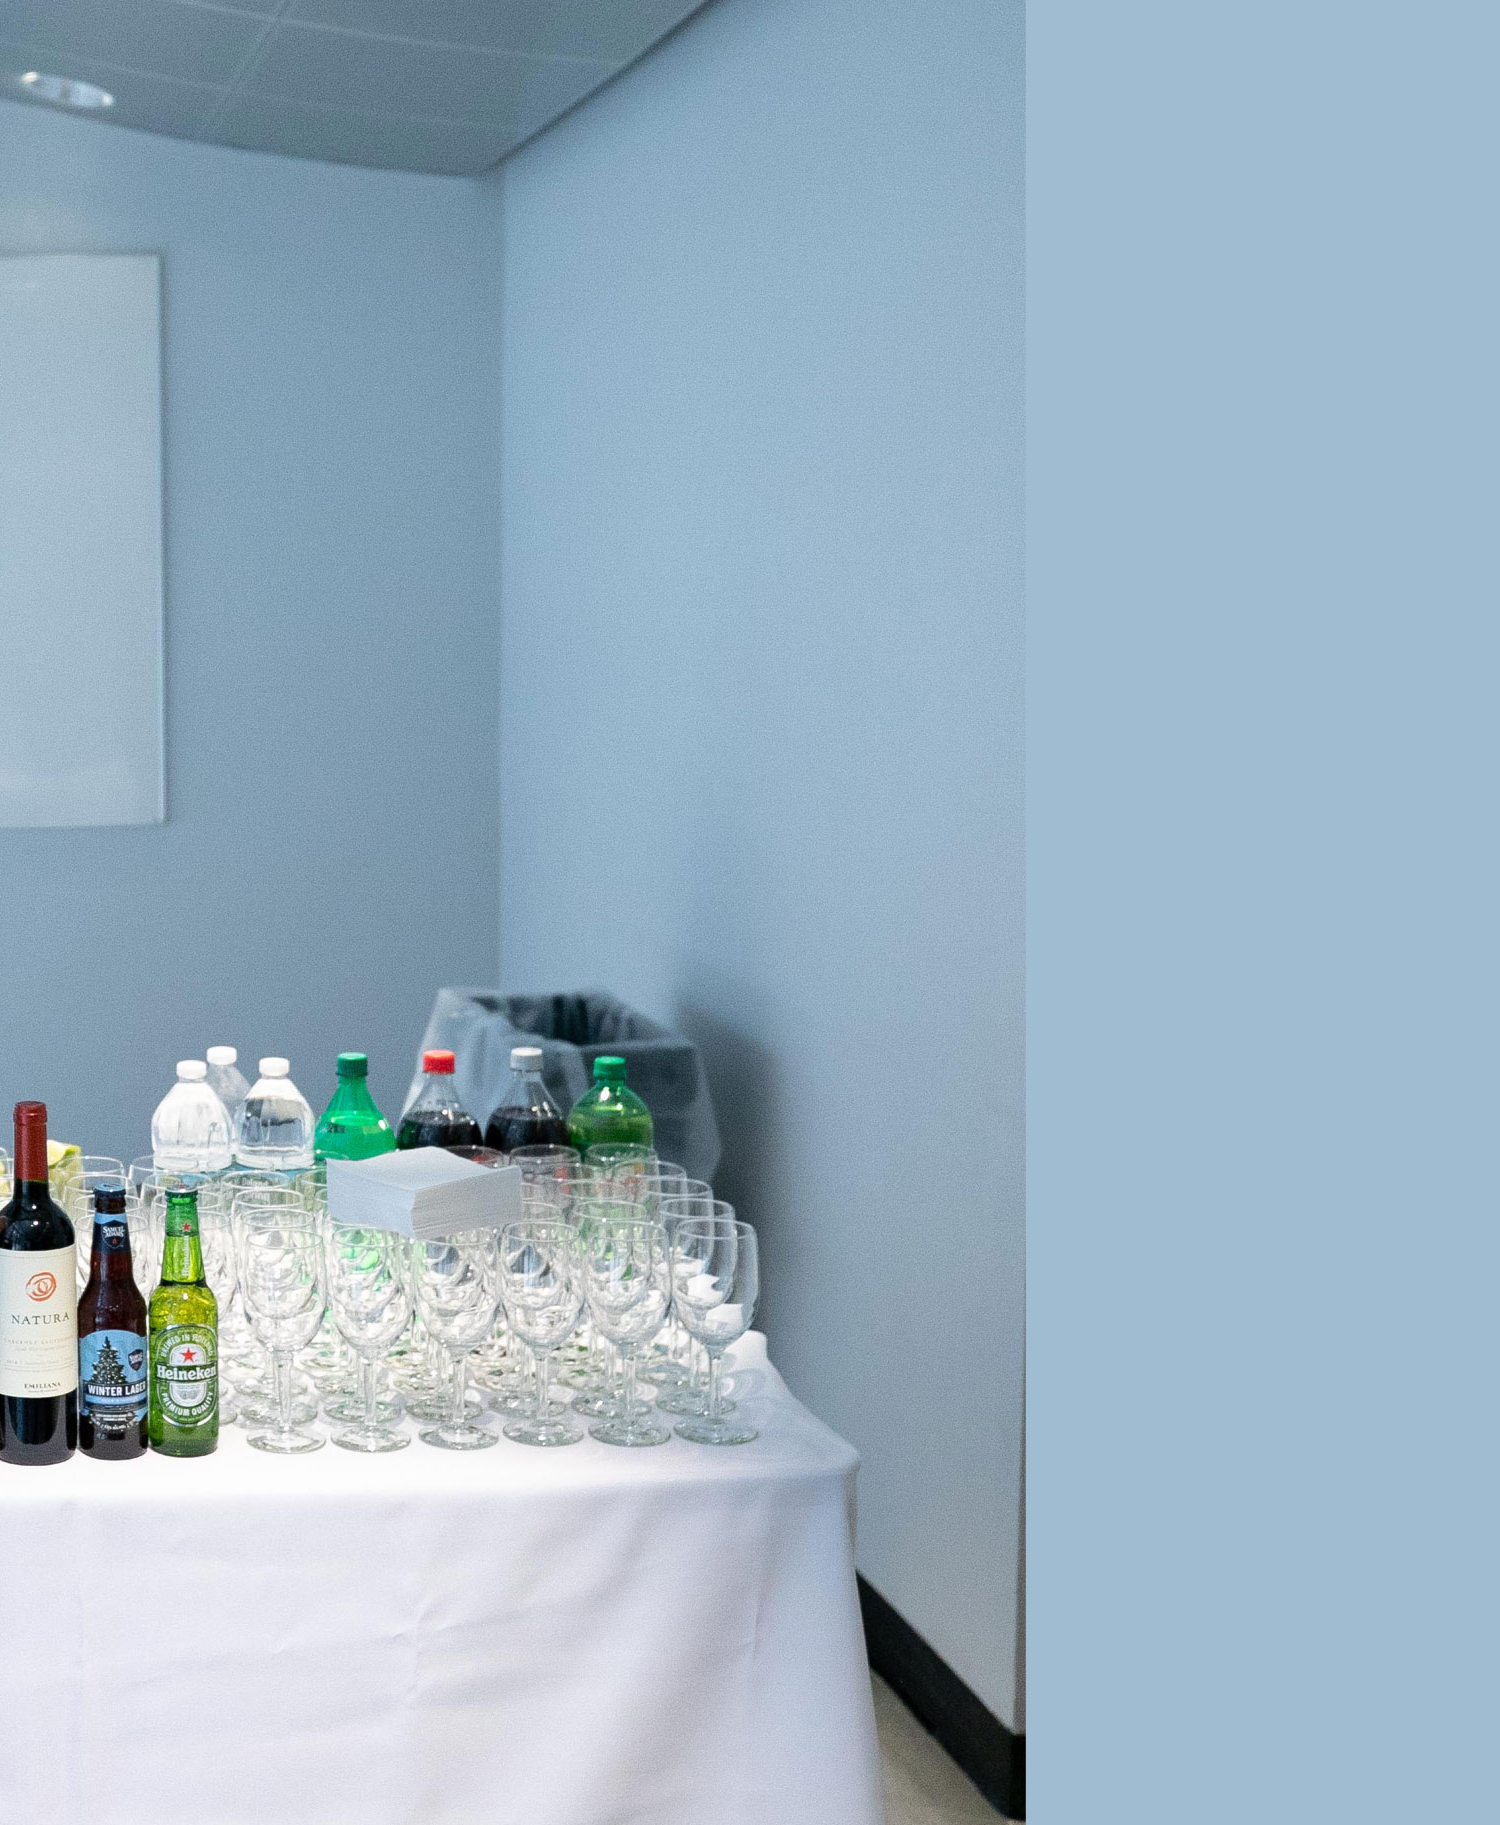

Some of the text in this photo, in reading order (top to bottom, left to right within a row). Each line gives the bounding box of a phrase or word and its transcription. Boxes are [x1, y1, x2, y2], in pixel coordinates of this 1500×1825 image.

[102, 1225, 126, 1234] SAMUEL
[104, 1230, 125, 1239] ADAMS
[11, 1311, 70, 1325] NATURA
[182, 1333, 191, 1342] IN
[156, 1364, 216, 1381] Heineken
[24, 1381, 61, 1389] EMILIANA
[88, 1381, 146, 1396] WINTER LAGER
[161, 1391, 214, 1417] PREMIUM QUALITY
